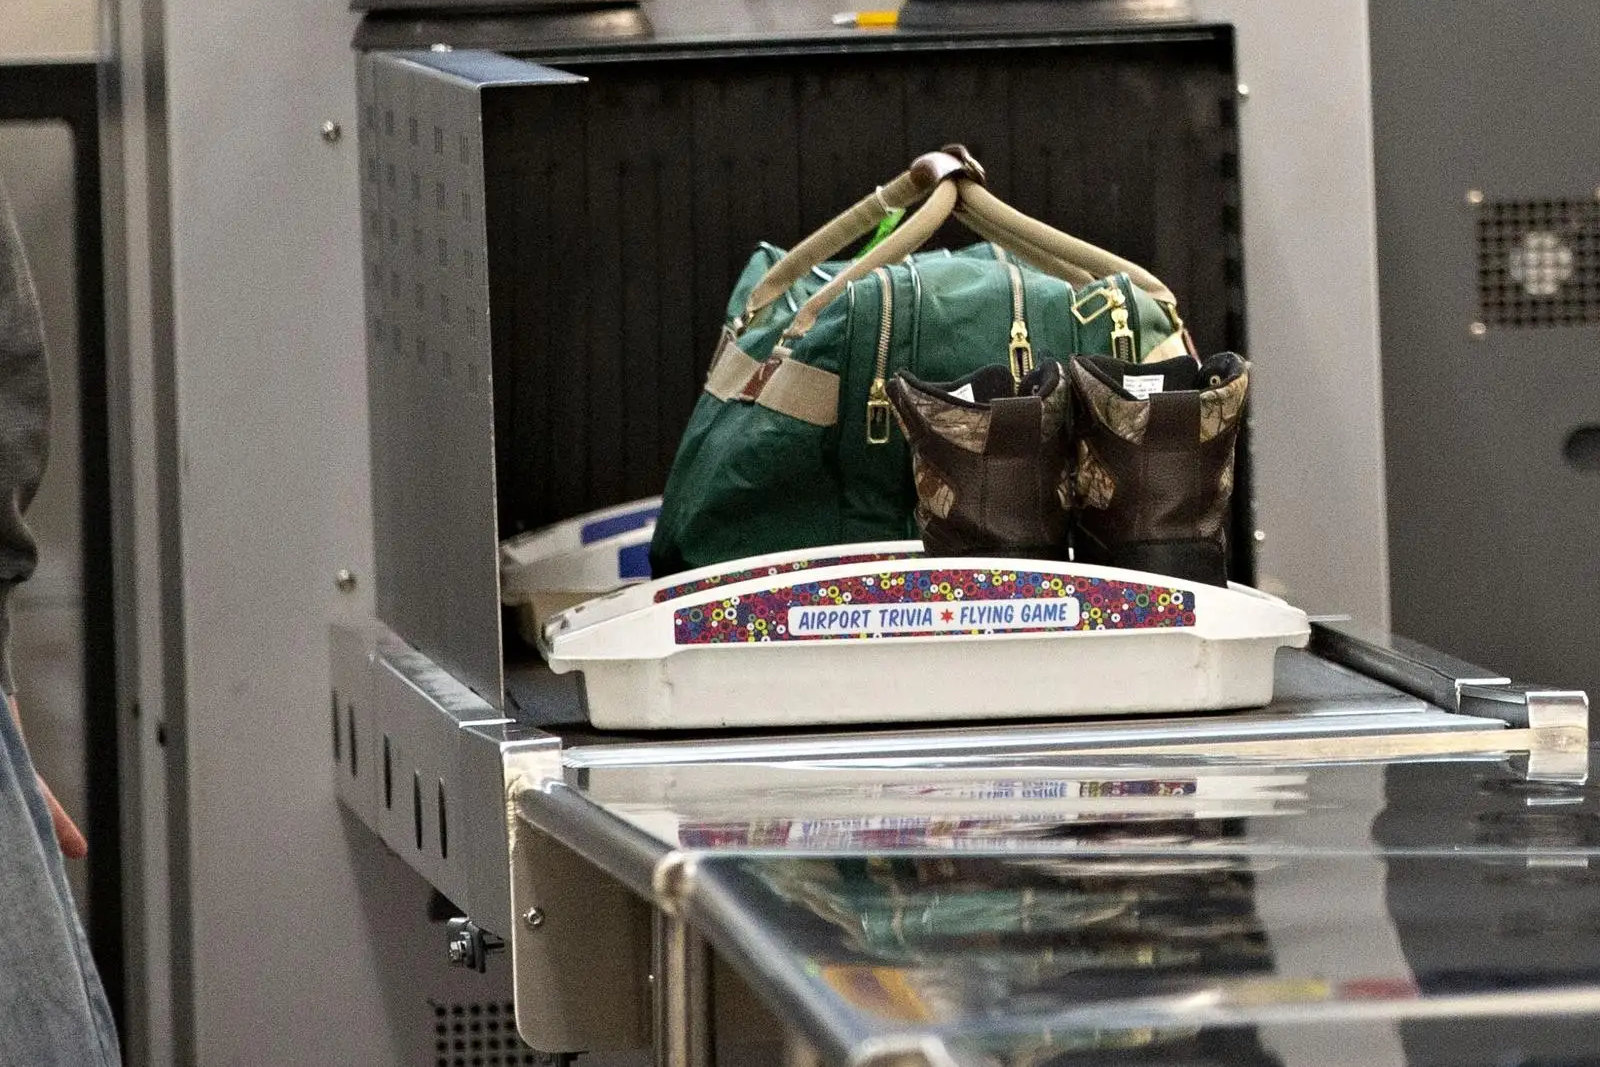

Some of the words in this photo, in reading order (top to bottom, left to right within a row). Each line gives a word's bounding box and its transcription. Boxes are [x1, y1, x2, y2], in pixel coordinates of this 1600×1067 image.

[799, 609, 871, 630] AIRPORT
[879, 608, 933, 627] TRIVIA
[960, 604, 1014, 624] FLYING
[1021, 602, 1068, 623] GAME
